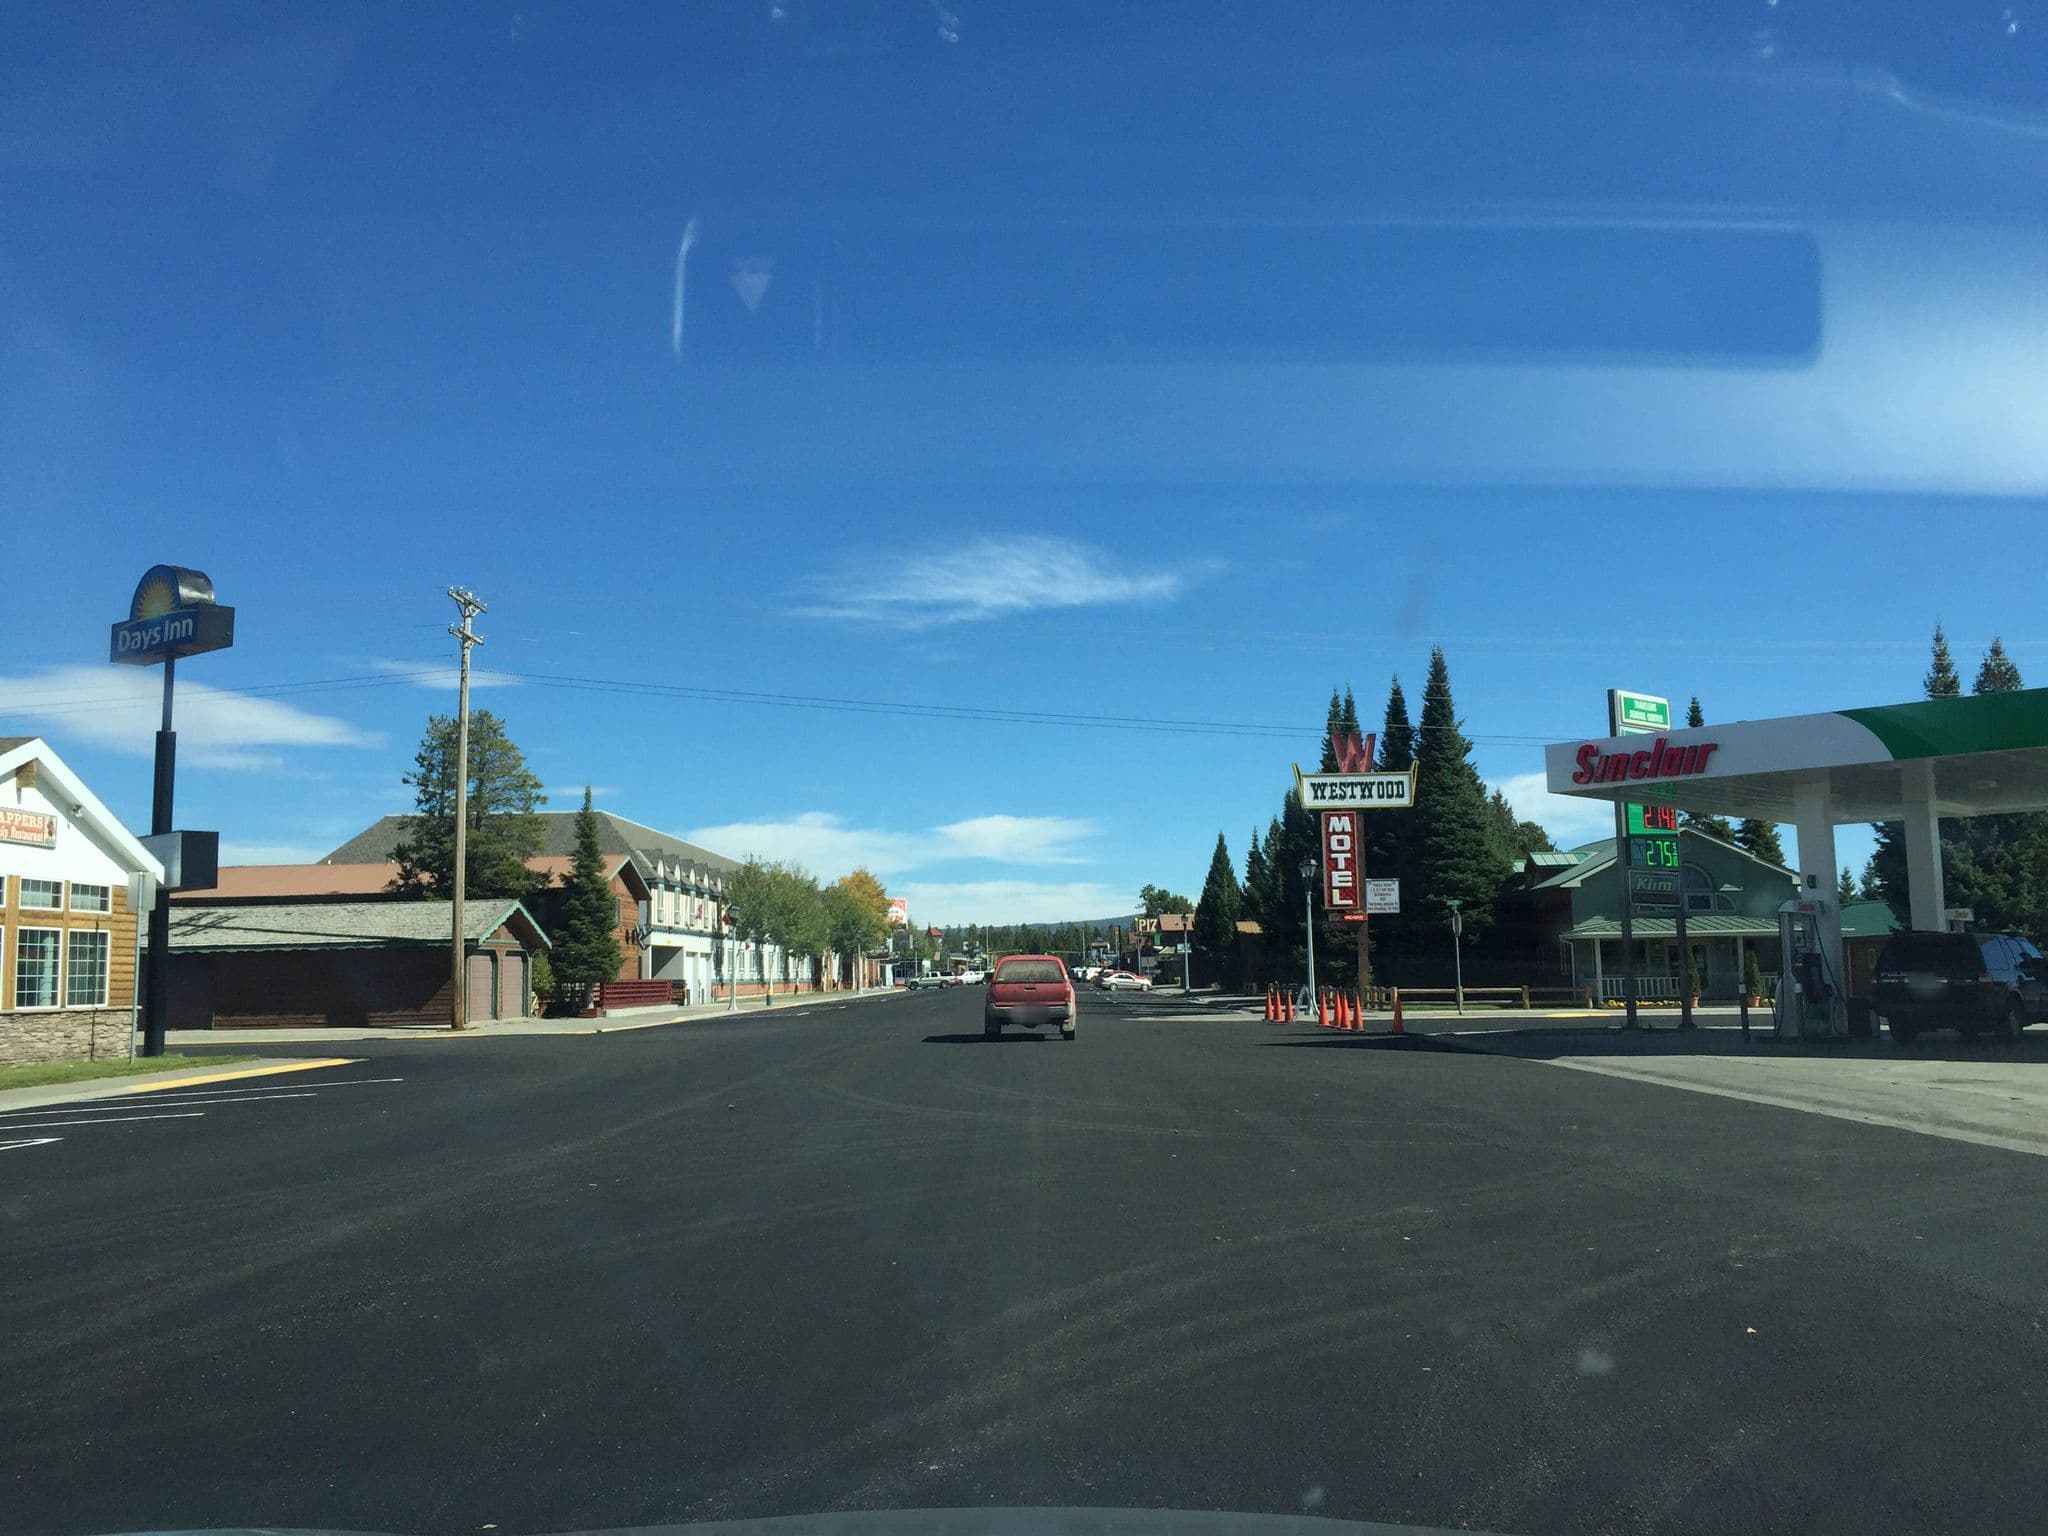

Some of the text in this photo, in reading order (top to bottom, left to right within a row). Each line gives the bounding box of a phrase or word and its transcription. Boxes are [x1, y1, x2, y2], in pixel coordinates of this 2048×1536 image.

[119, 618, 193, 652] Days Inn
[1331, 732, 1376, 773] W
[1572, 737, 1718, 784] Sinclair
[1310, 780, 1405, 800] WESTWOOD
[1328, 816, 1353, 905] MOTEL
